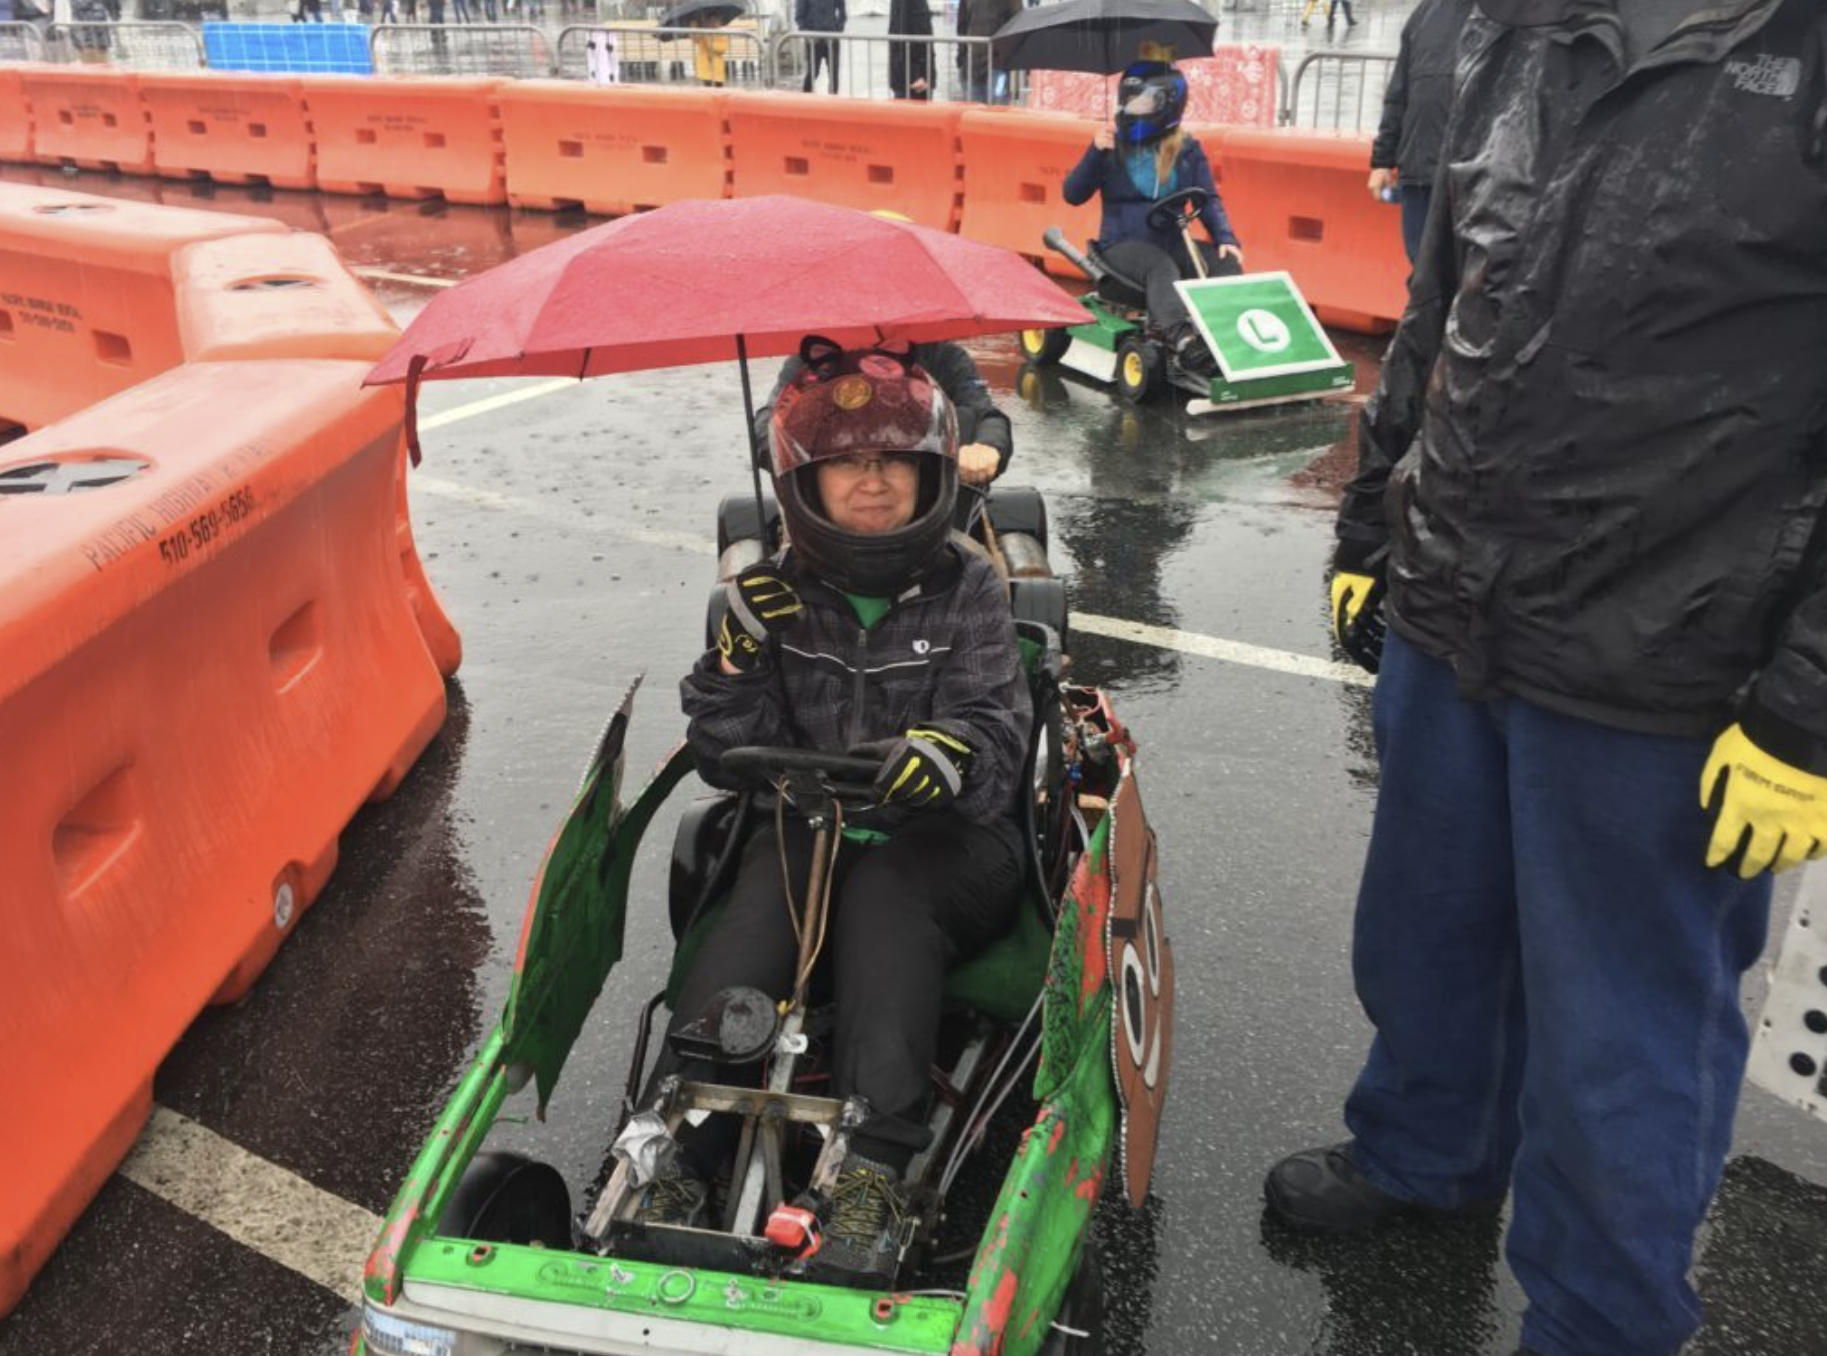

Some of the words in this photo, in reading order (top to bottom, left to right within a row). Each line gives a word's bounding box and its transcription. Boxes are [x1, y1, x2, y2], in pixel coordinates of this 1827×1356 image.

[1724, 61, 1780, 82] NORTH
[1756, 53, 1786, 71] THE
[1734, 76, 1778, 95] FACE
[1246, 317, 1280, 344] L
[79, 511, 157, 572] PACIFIC
